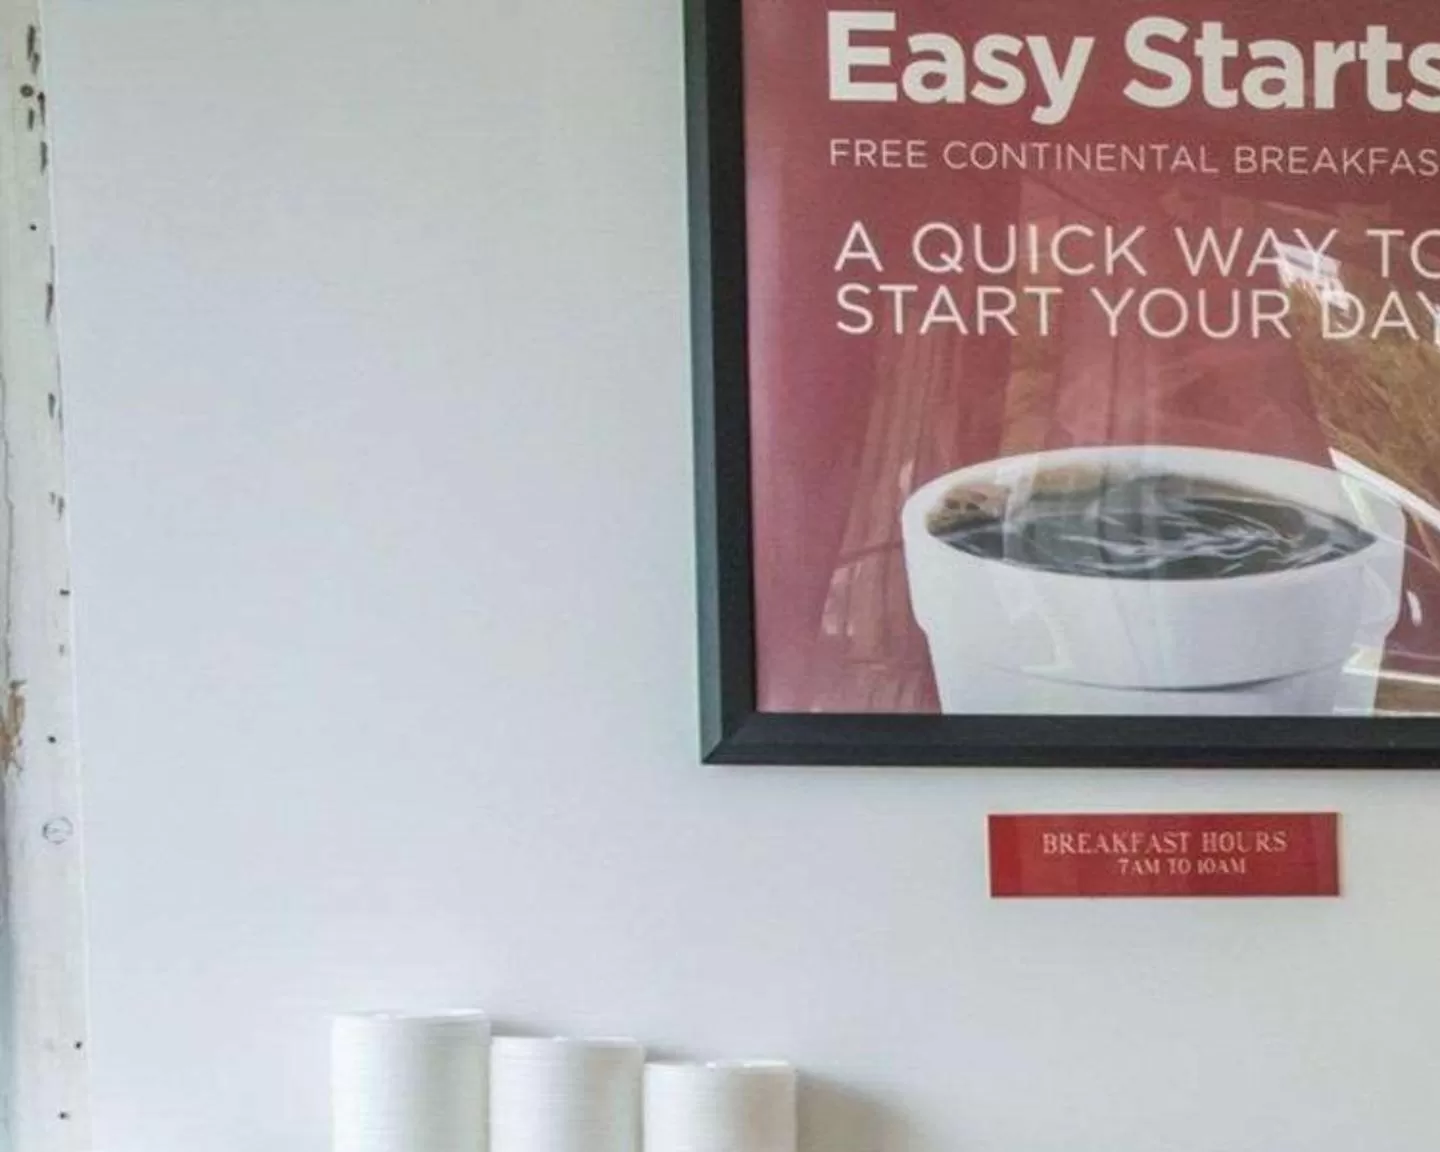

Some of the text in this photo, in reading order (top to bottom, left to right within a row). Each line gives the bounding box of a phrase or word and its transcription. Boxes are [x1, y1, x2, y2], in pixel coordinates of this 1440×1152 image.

[828, 10, 1094, 125] Easy
[830, 139, 928, 168] FREE
[943, 141, 1219, 174] CONTINENTAL
[834, 221, 882, 272] A
[912, 222, 1147, 278] QUICK
[1174, 226, 1339, 278] WAY
[836, 285, 1062, 336] START
[1090, 287, 1292, 340] YOUR
[1042, 831, 1288, 854] BREAKFAST HOURS
[1118, 858, 1246, 877] 7AM TO 10AM
